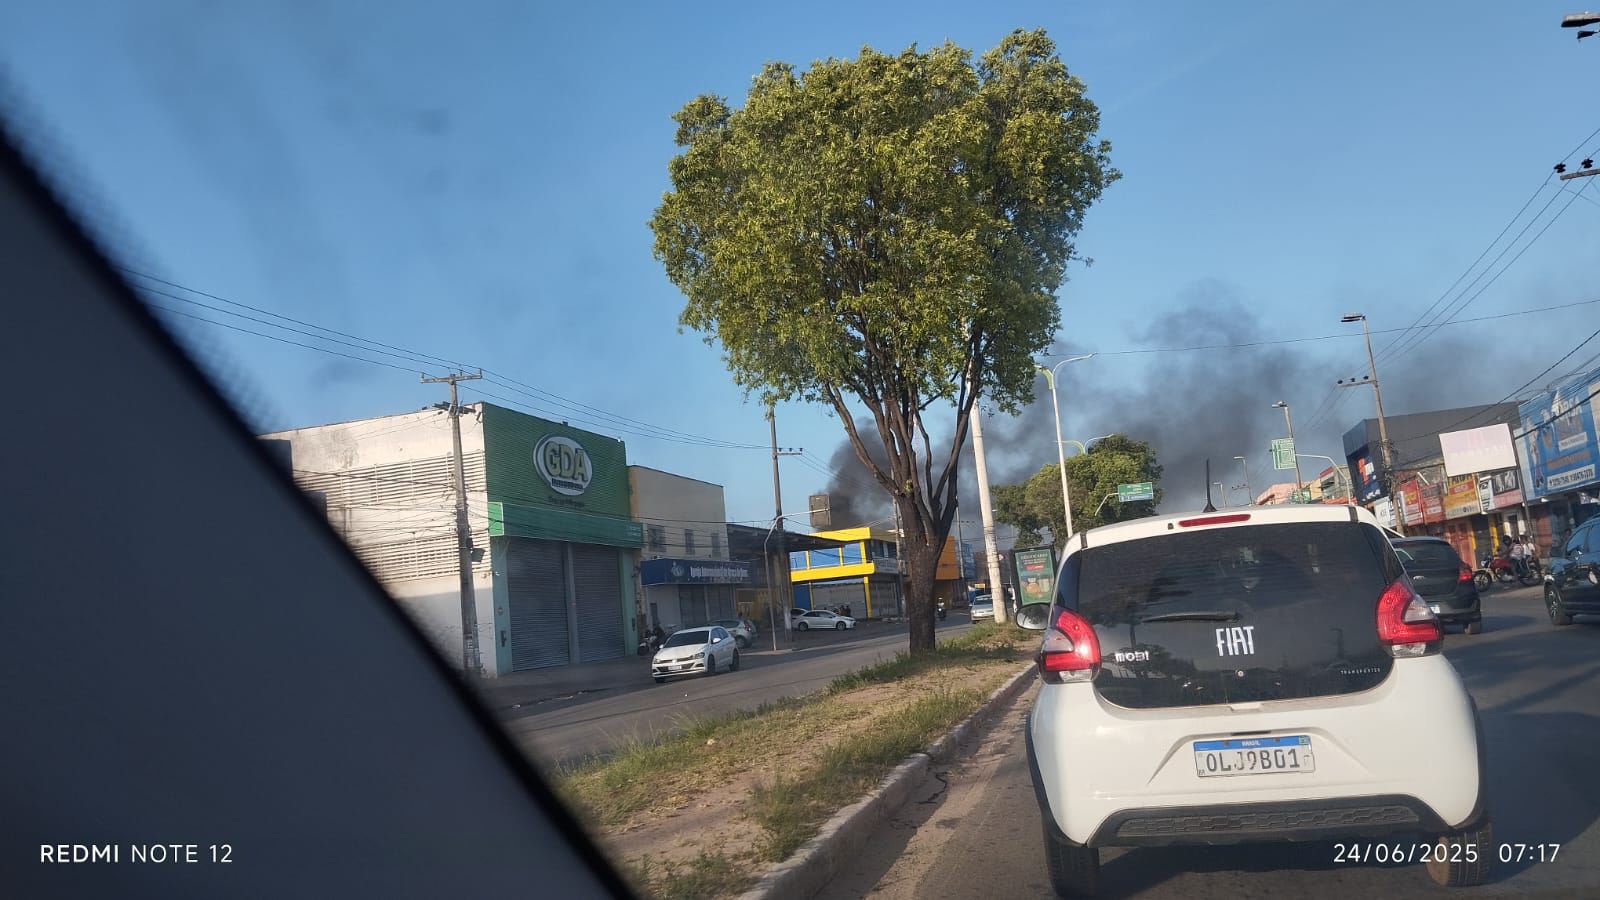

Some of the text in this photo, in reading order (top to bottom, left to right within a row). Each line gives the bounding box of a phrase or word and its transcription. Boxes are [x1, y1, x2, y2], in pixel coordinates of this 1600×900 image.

[544, 441, 587, 481] GDA
[1215, 626, 1255, 657] FIAT
[1205, 748, 1301, 772] OLJ9B01
